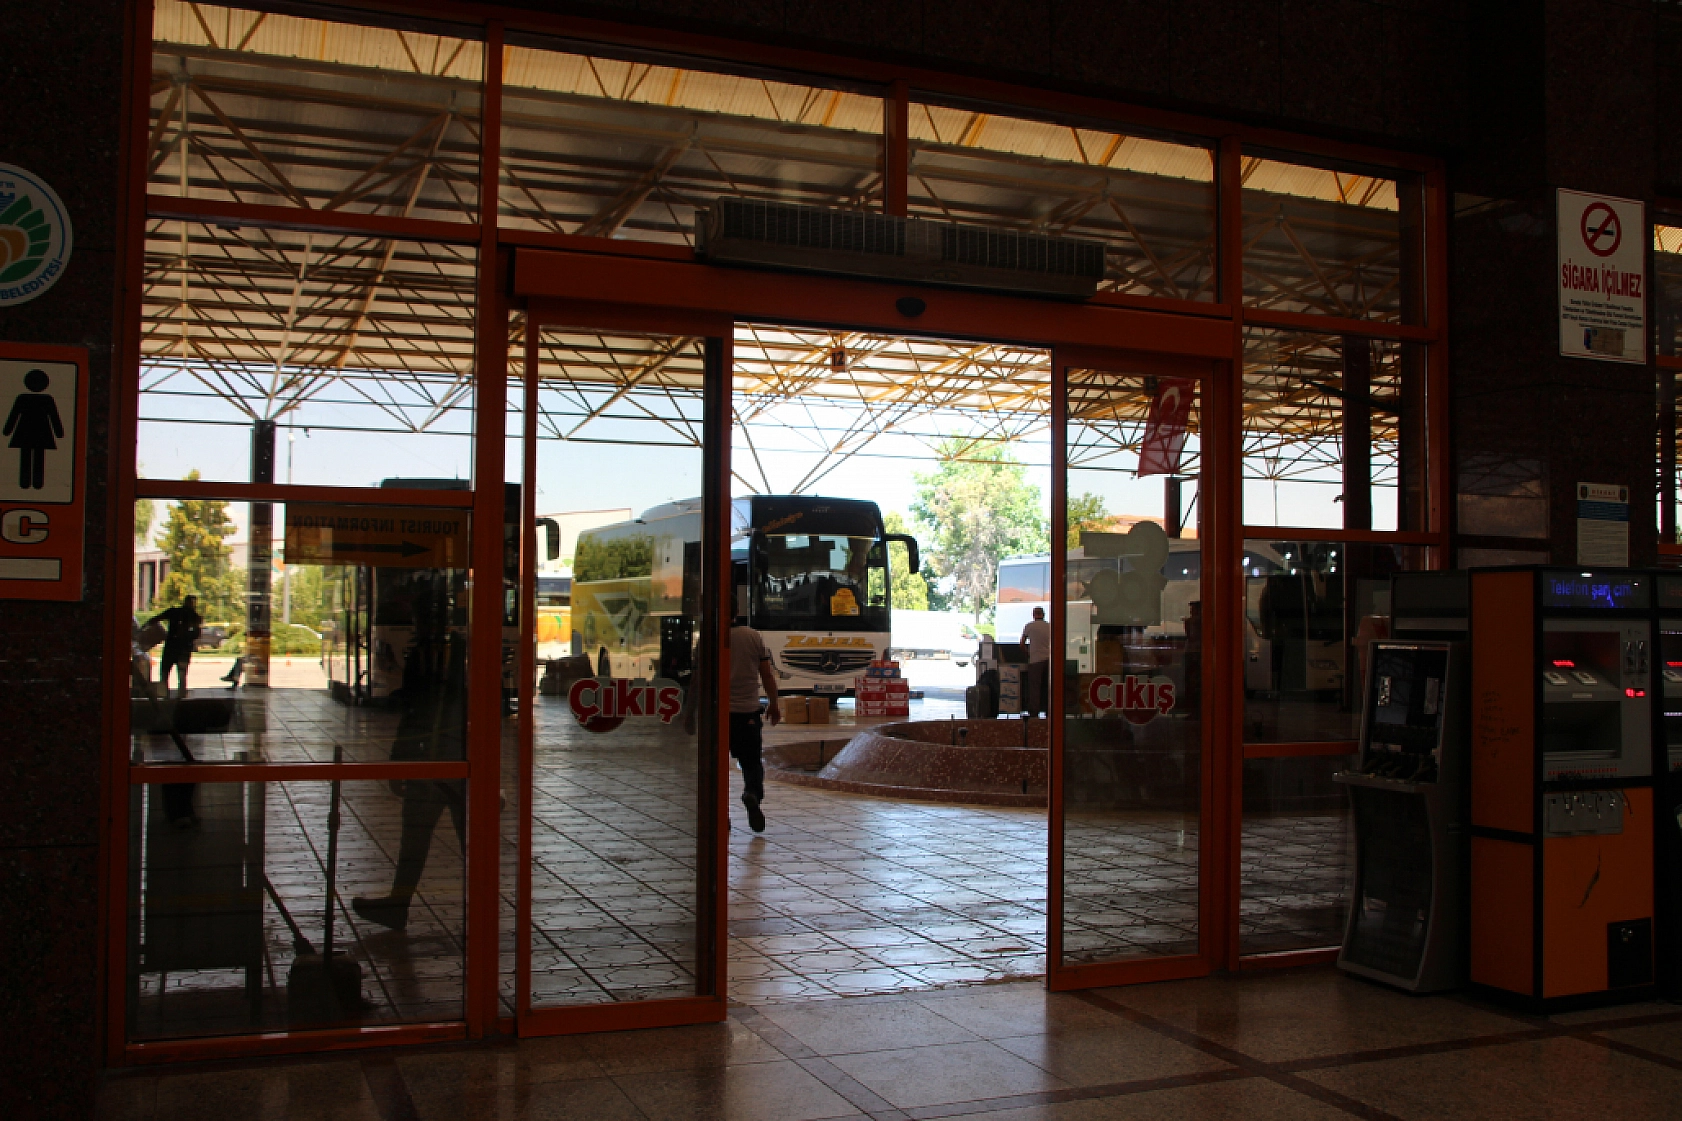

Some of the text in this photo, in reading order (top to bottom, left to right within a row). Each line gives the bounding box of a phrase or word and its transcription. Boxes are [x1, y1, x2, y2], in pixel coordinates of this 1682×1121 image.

[1562, 257, 1642, 301] SİGARA İÇİLMEZ
[0, 507, 49, 545] C
